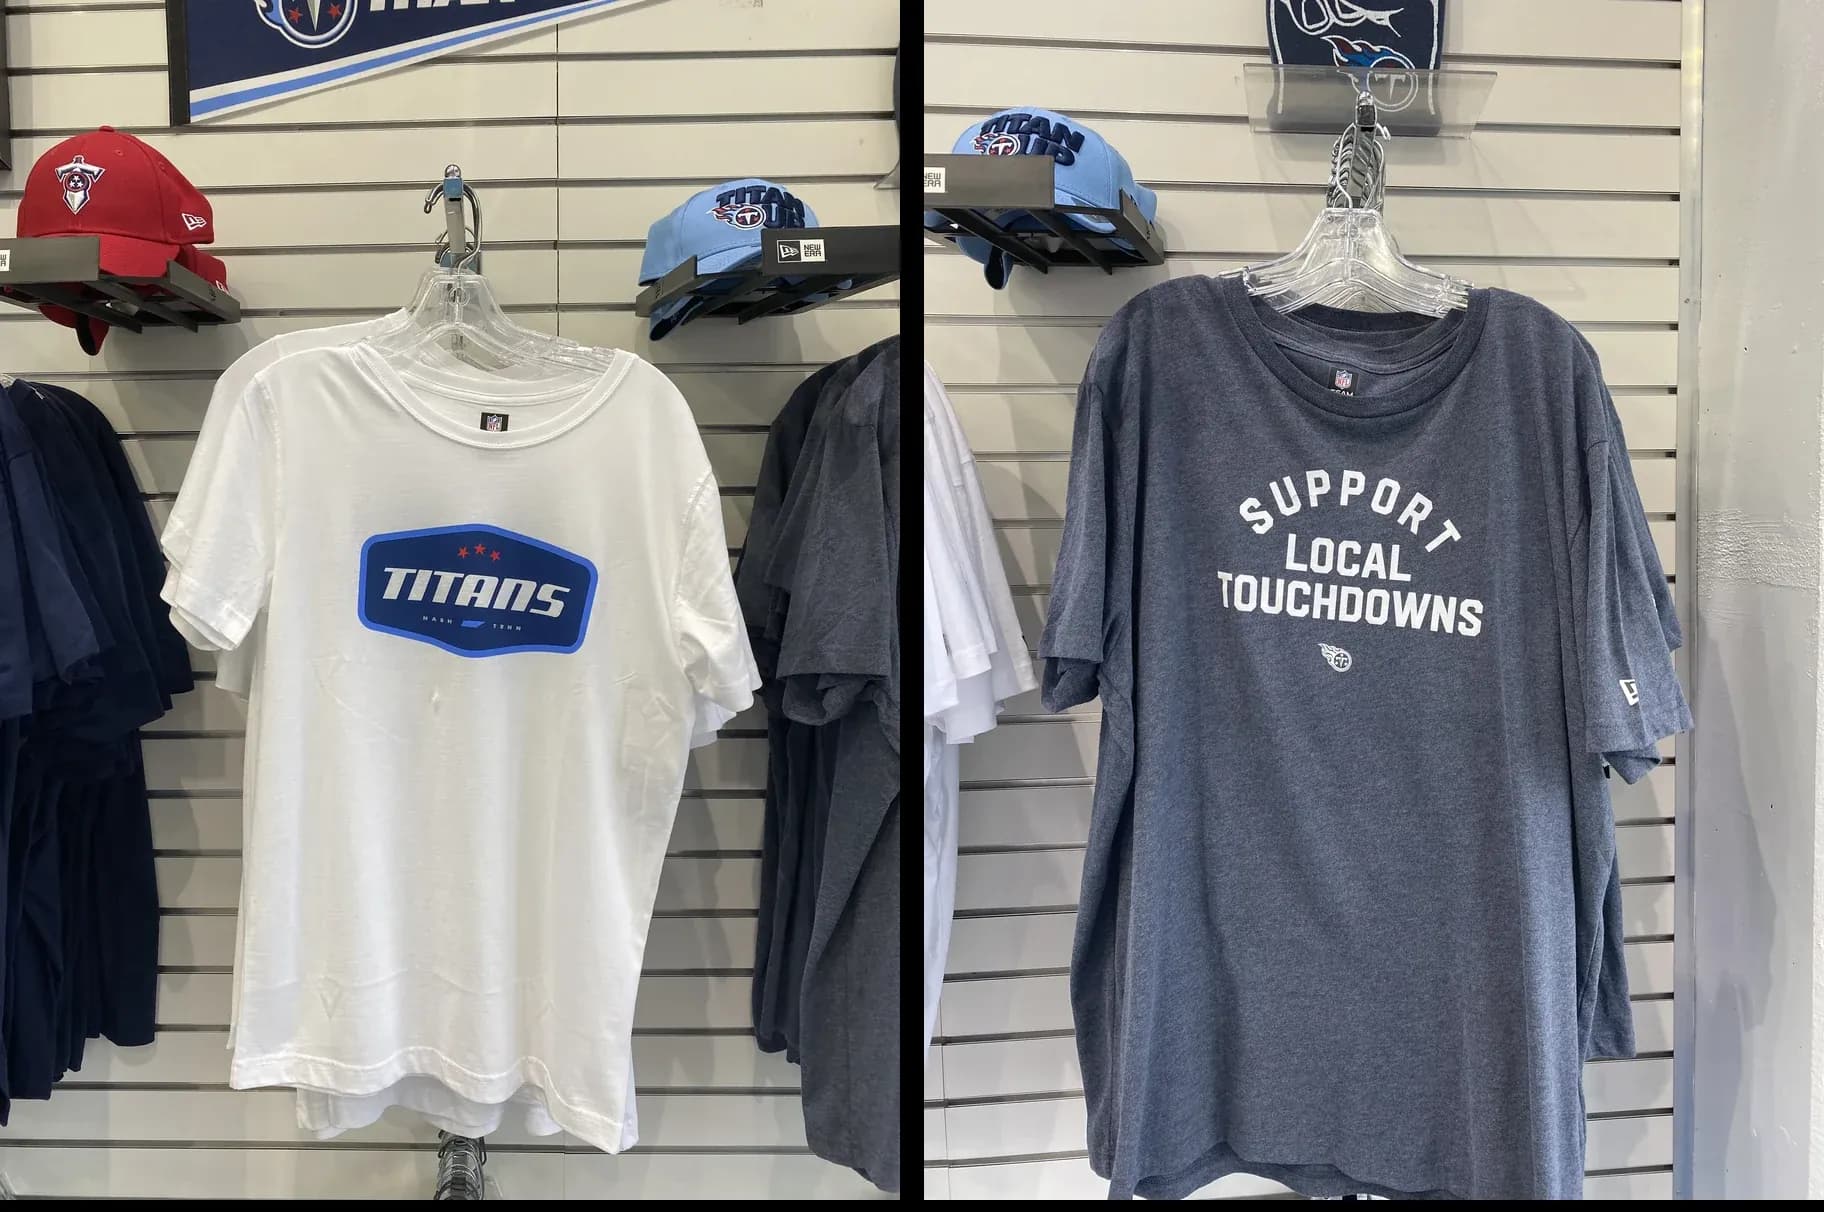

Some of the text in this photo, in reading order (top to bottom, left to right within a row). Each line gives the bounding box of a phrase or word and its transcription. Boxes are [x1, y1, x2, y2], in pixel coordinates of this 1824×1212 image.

[980, 113, 1085, 154] TITAN
[1018, 133, 1076, 167] UP
[803, 243, 821, 251] NEW
[1239, 469, 1462, 553] SUPPORT
[1285, 532, 1412, 582] LOCAL
[382, 566, 571, 618] TITANS
[1217, 571, 1484, 637] TOUCHDOWNS
[422, 615, 453, 625] NASH
